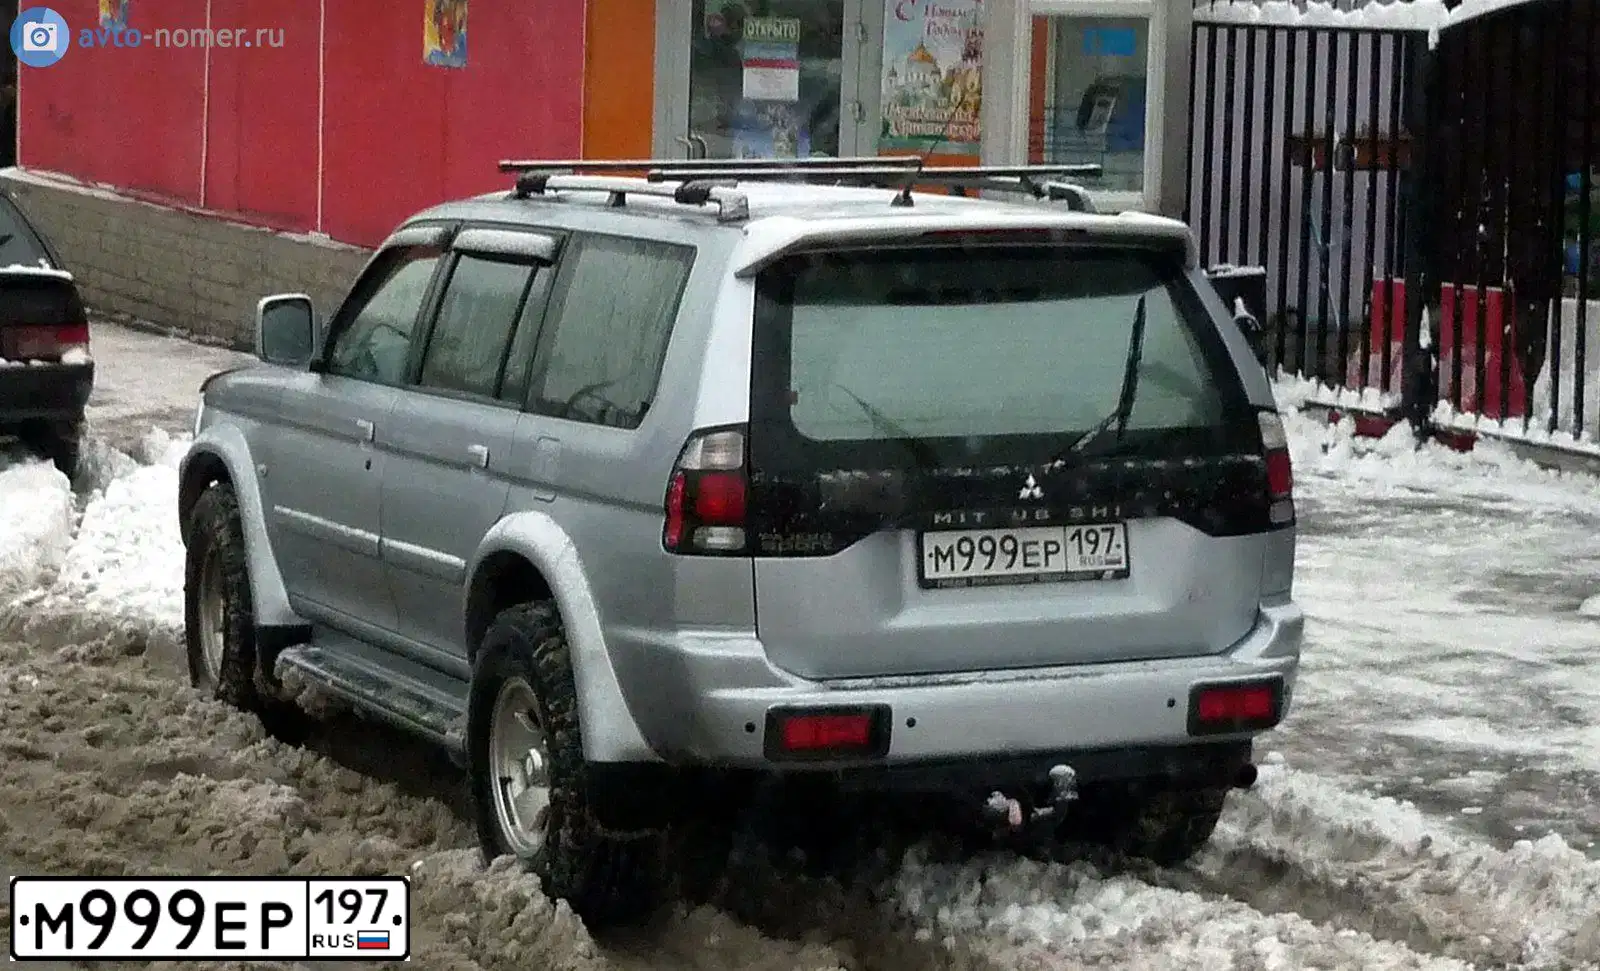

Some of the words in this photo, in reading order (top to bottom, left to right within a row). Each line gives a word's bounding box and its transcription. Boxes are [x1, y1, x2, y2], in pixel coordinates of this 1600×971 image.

[747, 21, 797, 38] ОТКРЫТО
[934, 534, 1061, 572] М999ЕР
[1069, 526, 1115, 556] 197
[1079, 555, 1103, 566] RUS
